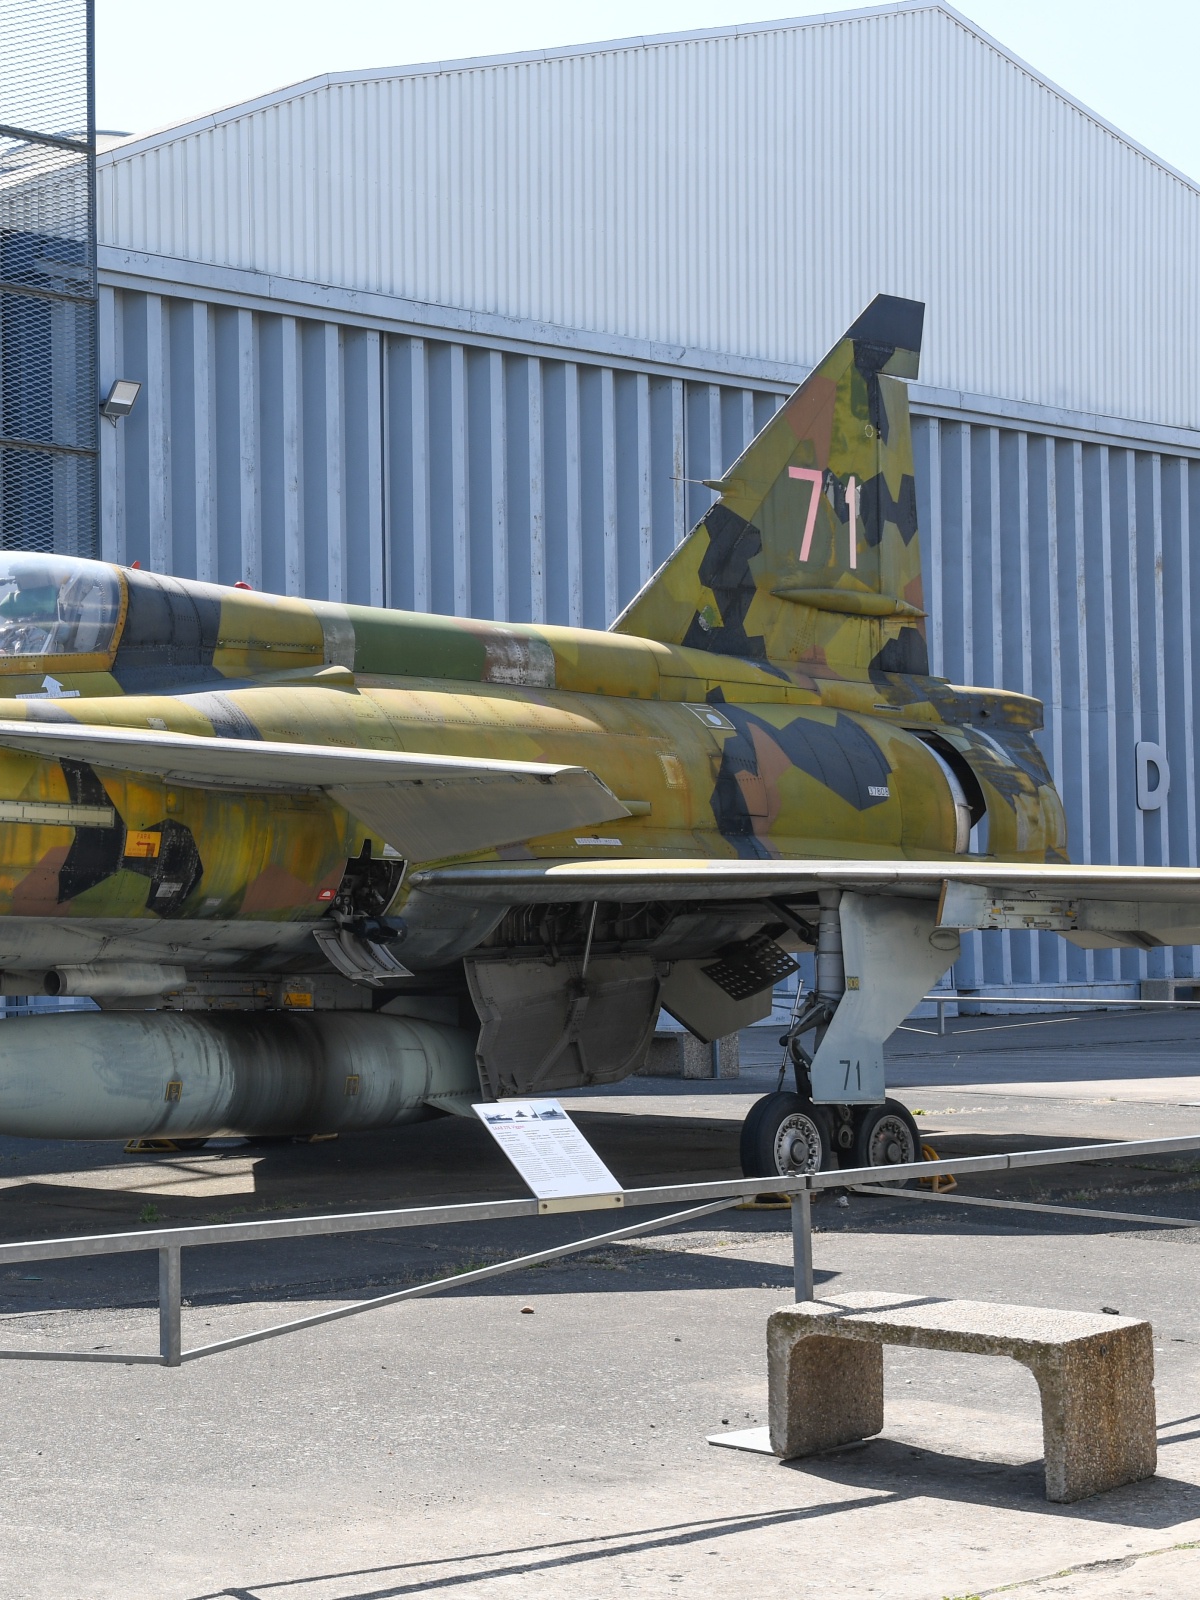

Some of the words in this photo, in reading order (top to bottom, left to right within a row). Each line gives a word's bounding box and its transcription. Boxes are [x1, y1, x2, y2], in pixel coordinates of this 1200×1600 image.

[788, 466, 857, 570] 71
[1135, 741, 1171, 810] D
[839, 1060, 861, 1091] 71
